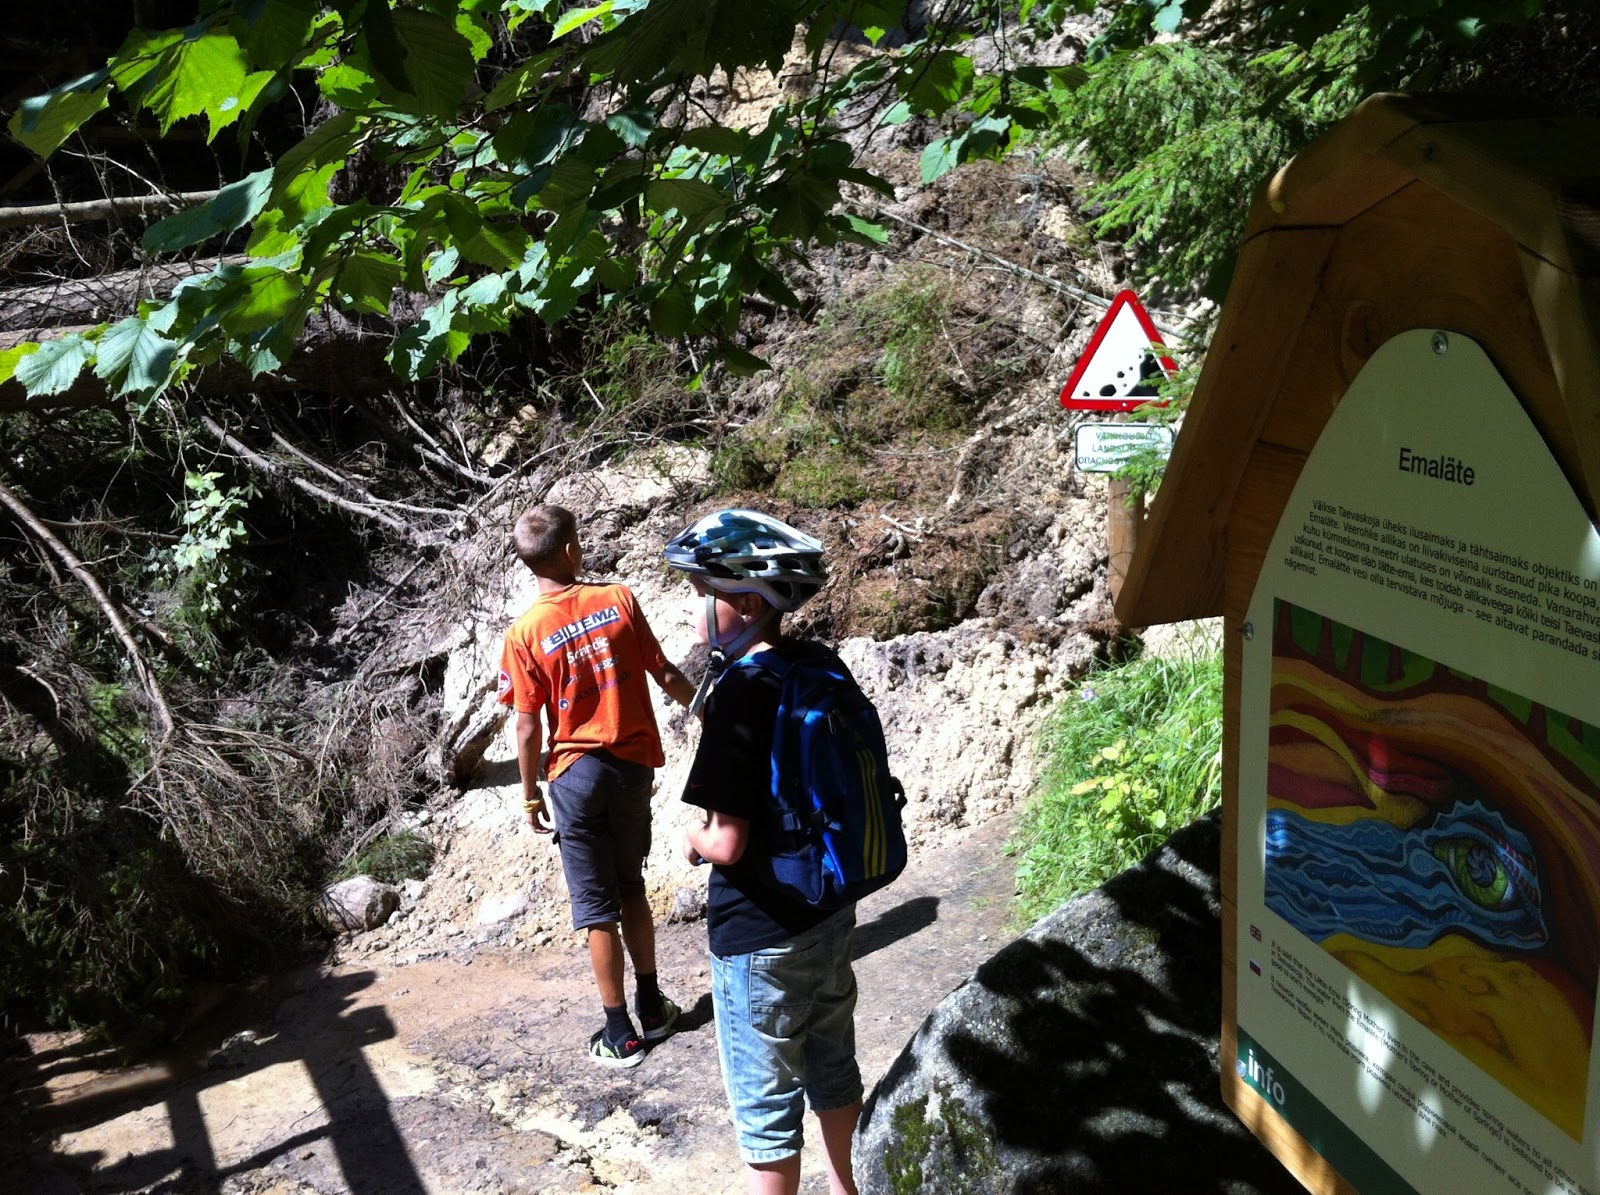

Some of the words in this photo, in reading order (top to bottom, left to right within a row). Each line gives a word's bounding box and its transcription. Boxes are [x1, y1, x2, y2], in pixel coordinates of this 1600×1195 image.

[1399, 447, 1475, 486] Emaläte
[1284, 556, 1318, 576] nägemist.
[1294, 535, 1324, 553] uskunud,
[1326, 545, 1334, 554] et
[1334, 545, 1360, 563] koopas
[1361, 555, 1376, 569] elab
[1378, 559, 1417, 583] lätte-ema,
[1420, 572, 1434, 588] kes
[1436, 579, 1462, 598] toidab
[1464, 590, 1514, 617] allikaveega
[1516, 604, 1539, 623] kõiki
[1540, 613, 1560, 631] teisi
[1303, 522, 1320, 536] kuhu
[1322, 528, 1370, 552] kümnekonna
[1372, 546, 1398, 561] meetri
[1401, 554, 1436, 574] ulatuses
[1440, 567, 1450, 578] on
[1454, 570, 1492, 591] võimalik
[1495, 583, 1541, 607] siseneda.
[1309, 512, 1340, 529] Emaläte.
[1343, 521, 1378, 541] Veerohke
[1380, 533, 1406, 550] allikas
[1409, 543, 1420, 554] on
[1422, 544, 1479, 572] liivakiviseina
[1482, 564, 1535, 589] uuristanud
[1538, 581, 1560, 597] pika
[1564, 587, 1600, 610] koopa,
[1312, 499, 1336, 515] Väikse
[1338, 506, 1380, 528] Taevaskoja
[1383, 517, 1406, 535] üheks
[1410, 525, 1456, 549] ilusaimaks
[1456, 539, 1466, 554] ja
[1470, 543, 1529, 571] tähtsaimaks
[1532, 563, 1580, 586] objektiks
[1584, 578, 1597, 591] on
[1290, 545, 1316, 562] allikaid.
[1318, 553, 1350, 574] Emalätte
[1352, 568, 1368, 580] vesi
[1370, 572, 1384, 585] olla
[1386, 577, 1428, 600] tervistava
[1430, 594, 1464, 614] mõjuga
[1475, 609, 1492, 622] see
[1494, 615, 1529, 636] aitavat
[1532, 629, 1588, 656] parandada
[1248, 1048, 1285, 1106] info
